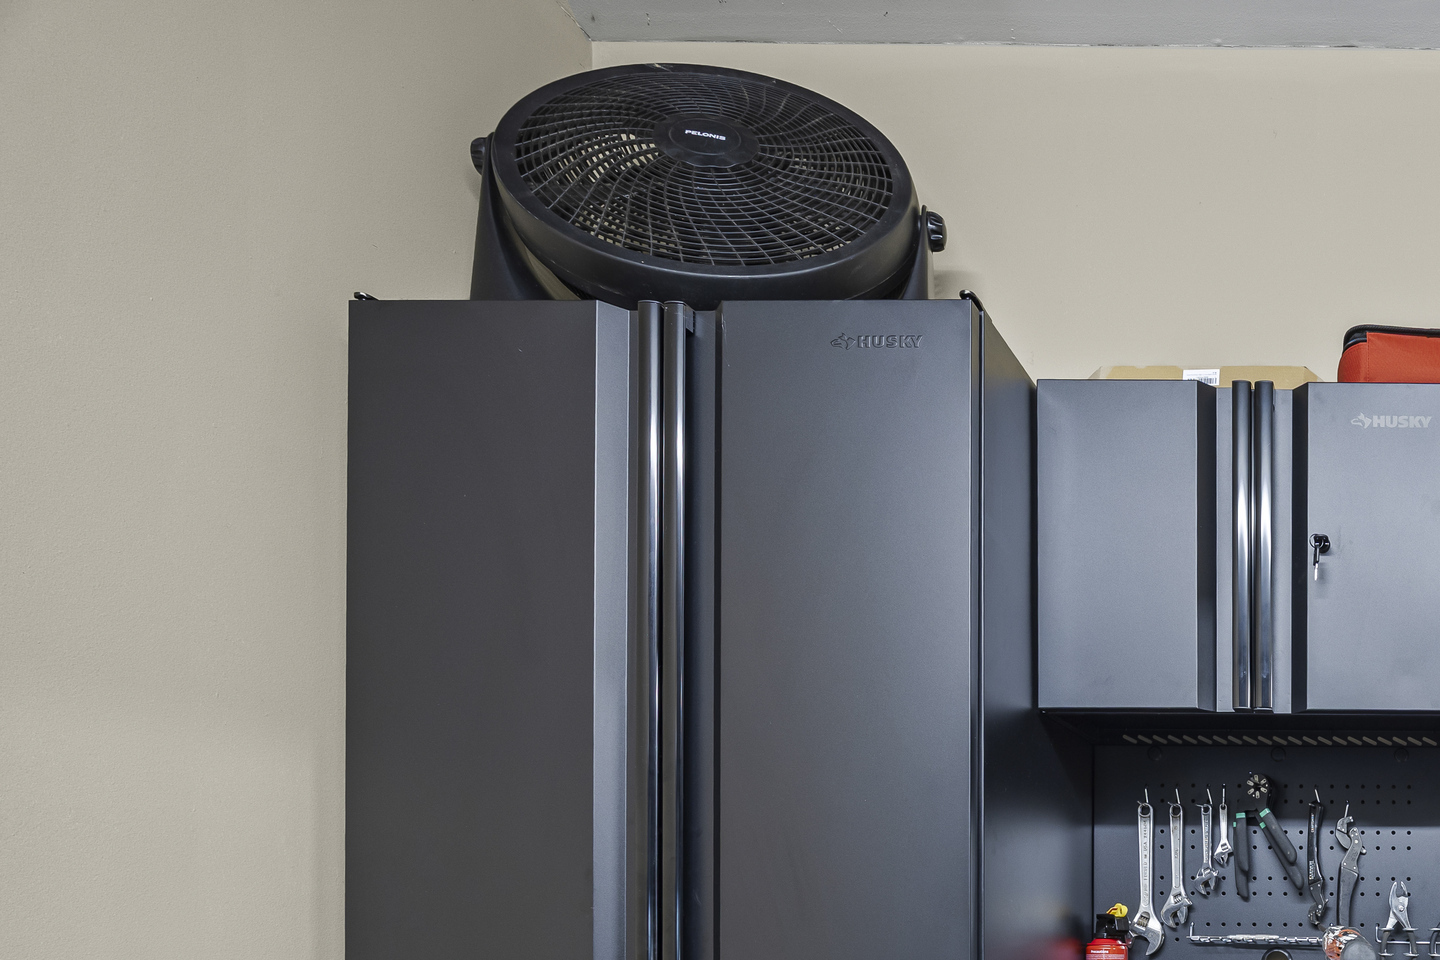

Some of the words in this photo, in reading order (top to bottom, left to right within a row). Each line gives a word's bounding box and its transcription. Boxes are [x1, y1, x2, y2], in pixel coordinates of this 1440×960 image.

[684, 129, 726, 141] PELONIS
[857, 335, 922, 348] HUSKY
[1372, 415, 1432, 429] HUSKY
